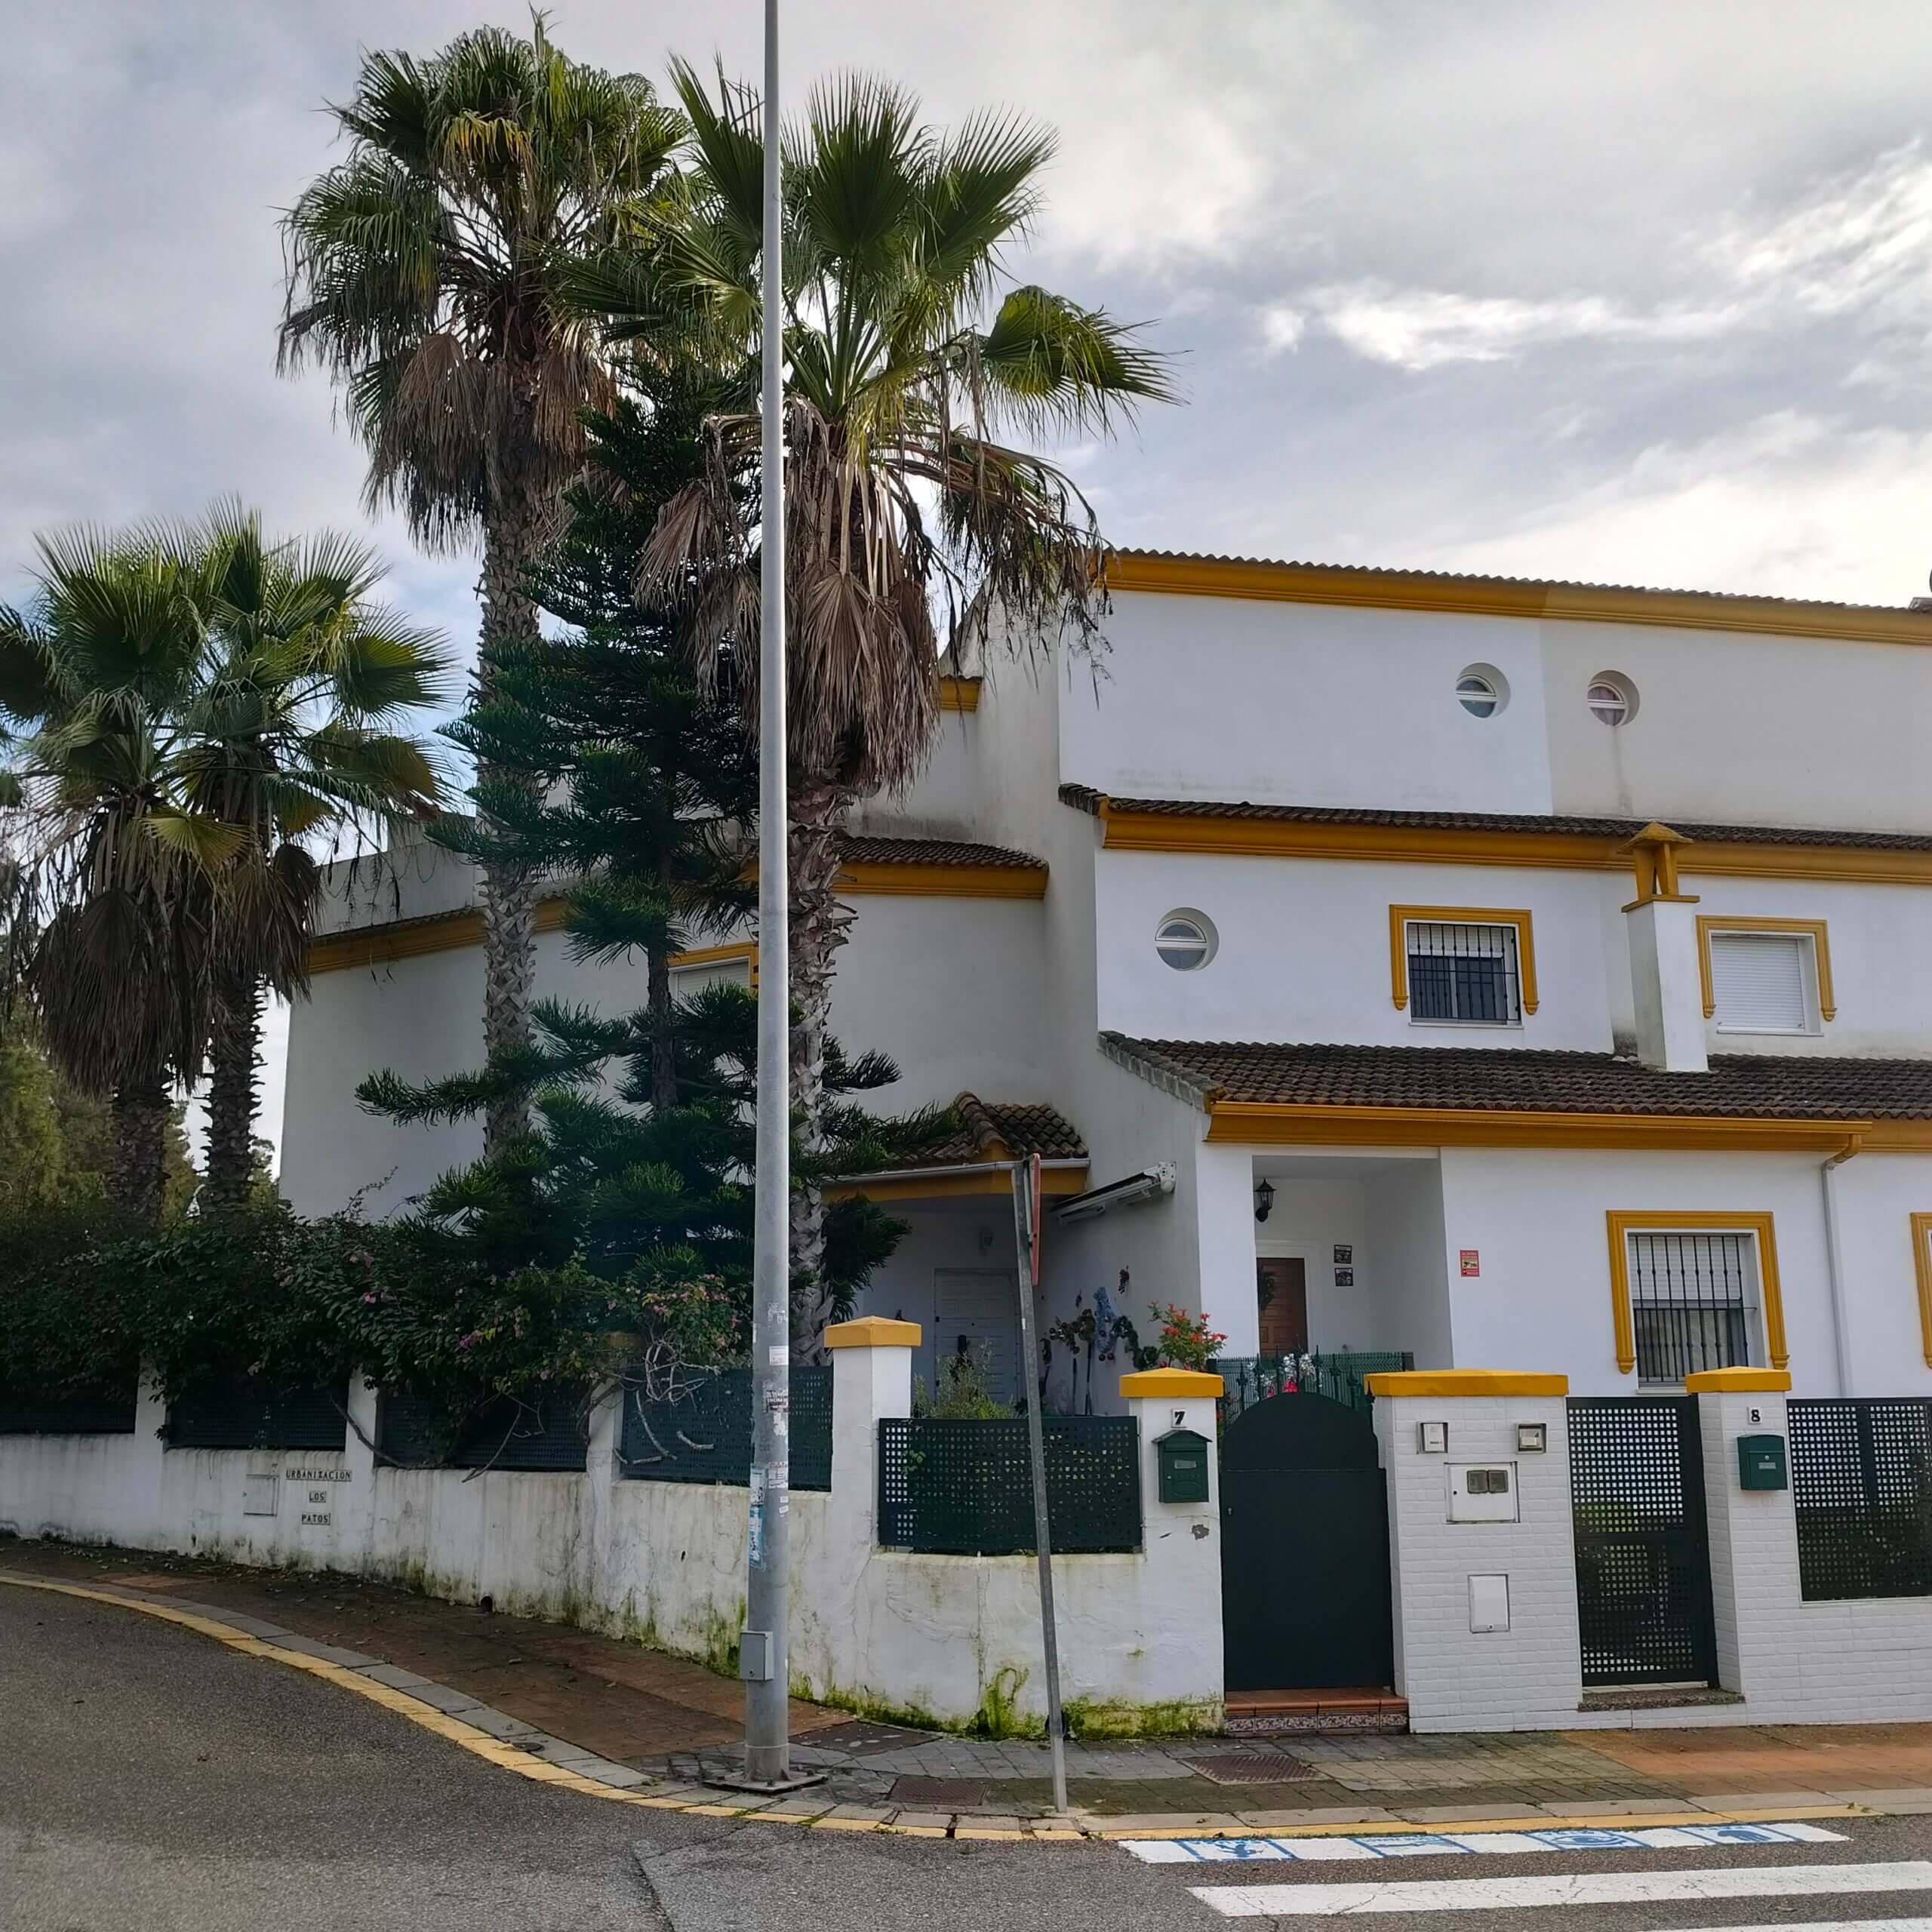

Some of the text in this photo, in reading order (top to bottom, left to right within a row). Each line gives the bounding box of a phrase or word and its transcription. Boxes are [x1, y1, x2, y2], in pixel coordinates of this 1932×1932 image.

[1174, 1411, 1186, 1425] 7
[1751, 1409, 1761, 1422] 8
[286, 1470, 351, 1480] URBANIZACION
[309, 1493, 325, 1502] LOS
[302, 1515, 329, 1524] PATOS
